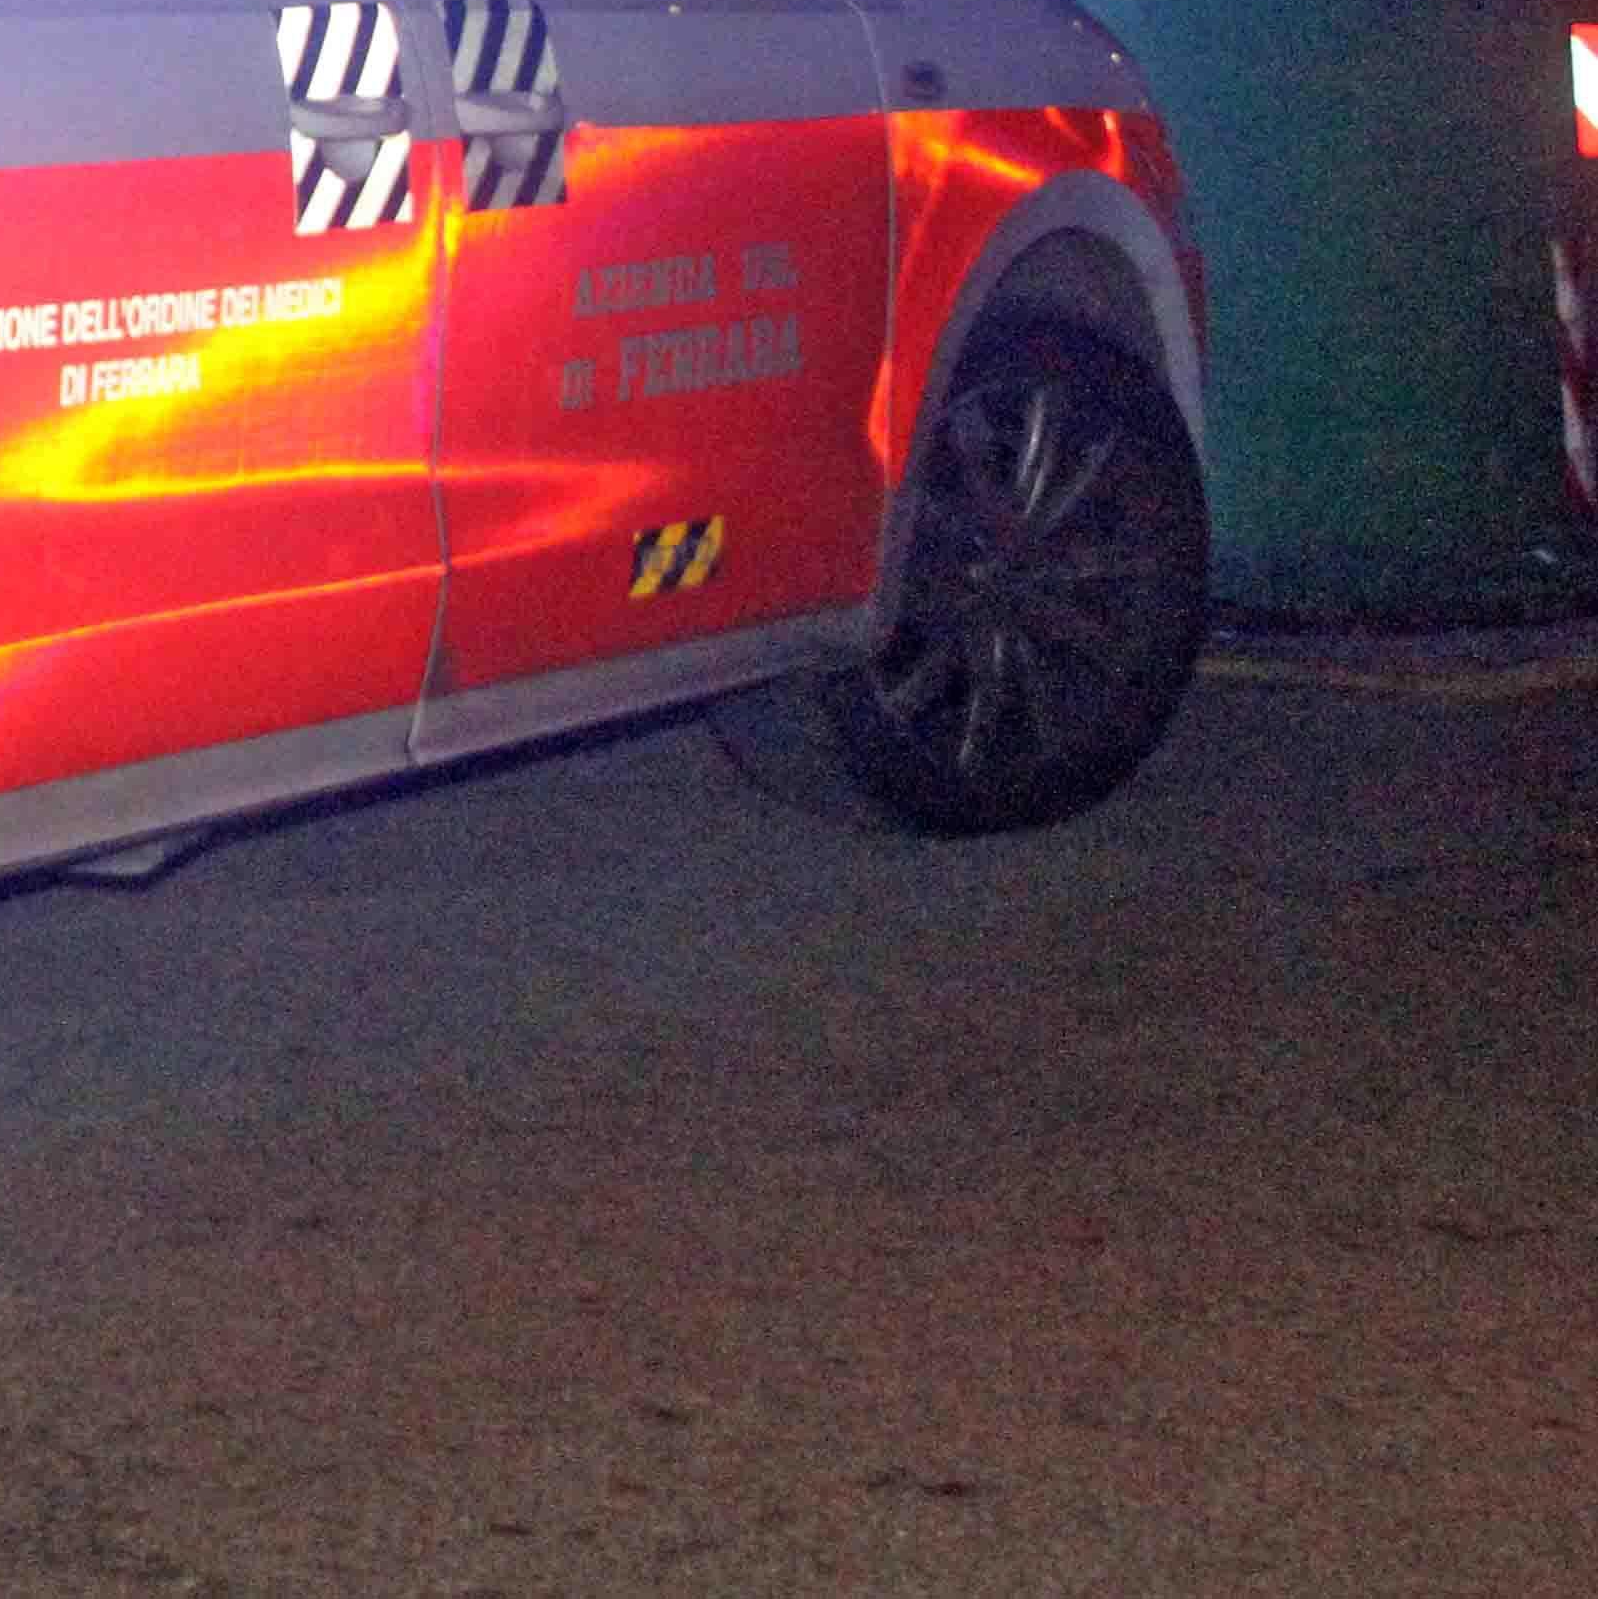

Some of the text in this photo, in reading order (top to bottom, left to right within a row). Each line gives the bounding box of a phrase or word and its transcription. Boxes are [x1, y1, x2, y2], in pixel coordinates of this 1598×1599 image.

[62, 289, 216, 345] DELL'ORDINE
[220, 285, 261, 329] DEI
[265, 278, 344, 321] MEDICI
[60, 352, 202, 408] DI FERRARA
